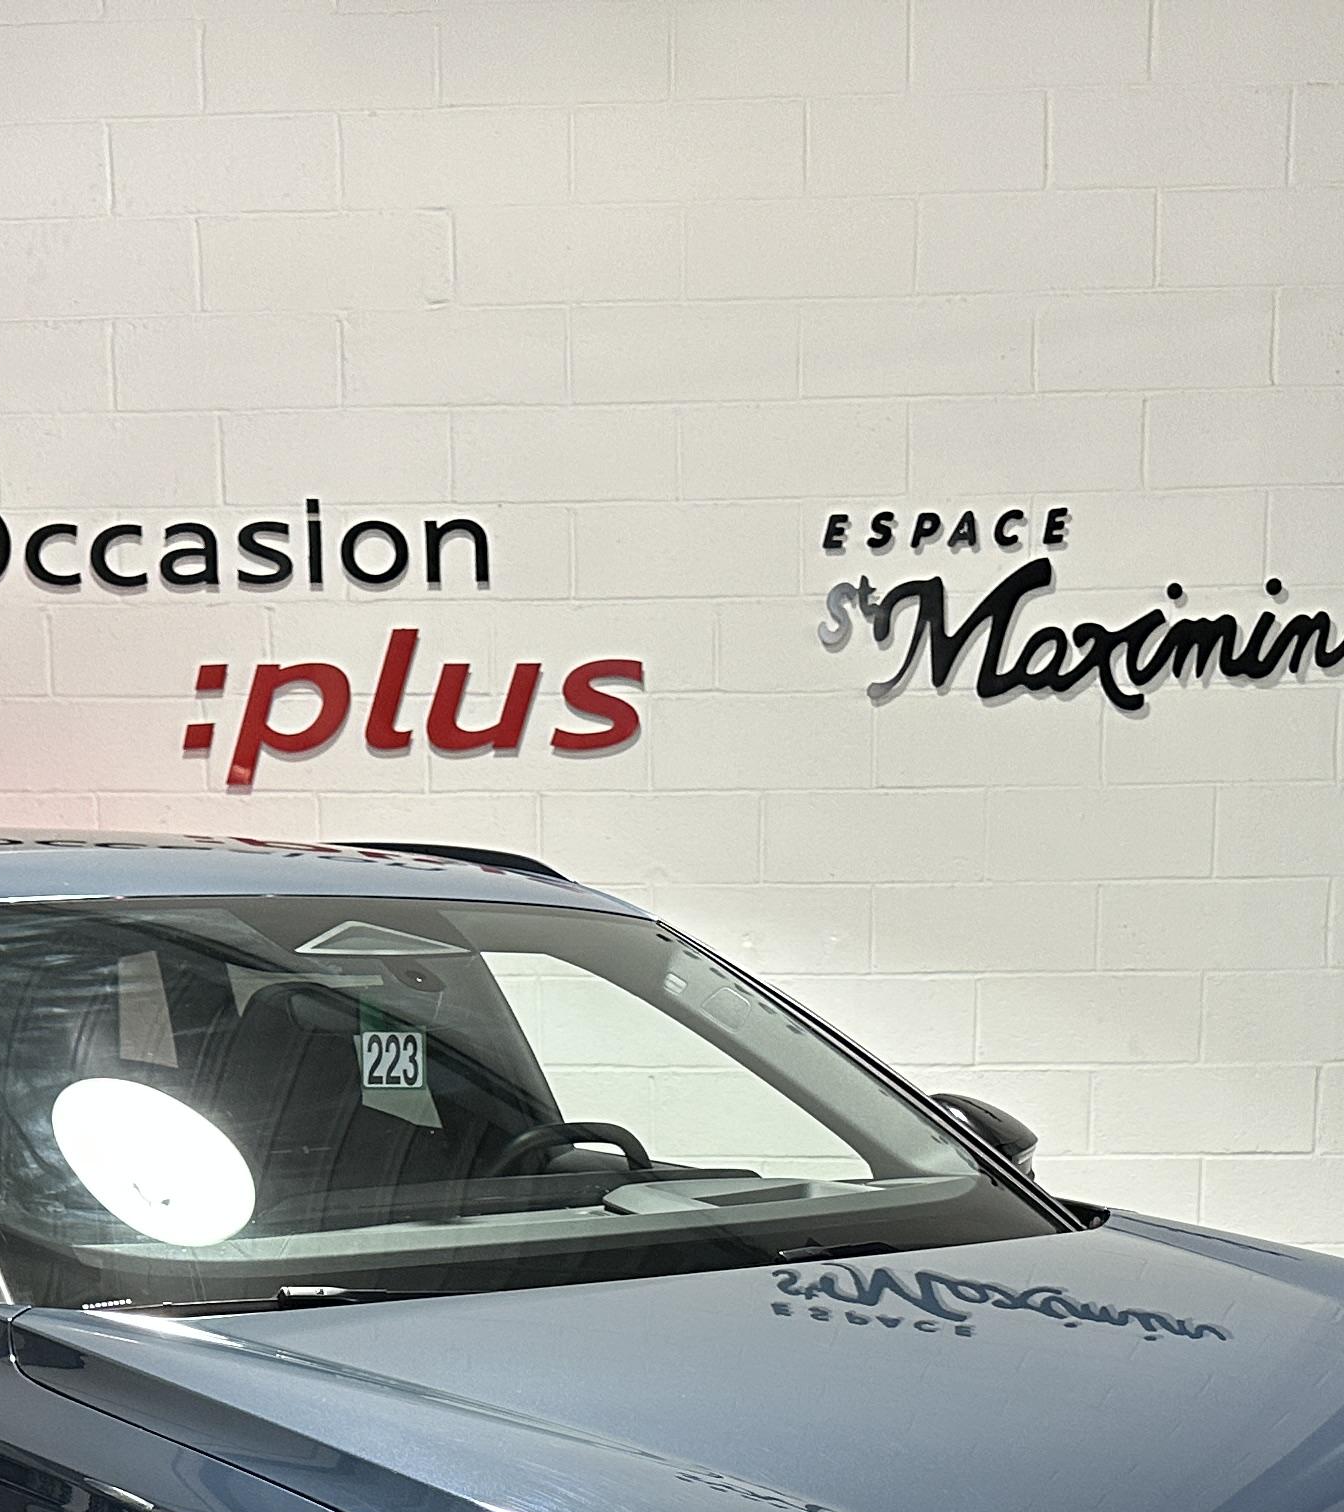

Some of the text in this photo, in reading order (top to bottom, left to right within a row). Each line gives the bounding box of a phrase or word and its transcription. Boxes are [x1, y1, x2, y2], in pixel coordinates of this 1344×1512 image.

[823, 508, 1069, 550] ESPACE
[819, 575, 879, 646] St
[183, 629, 643, 786] :plus
[367, 1033, 420, 1087] 223
